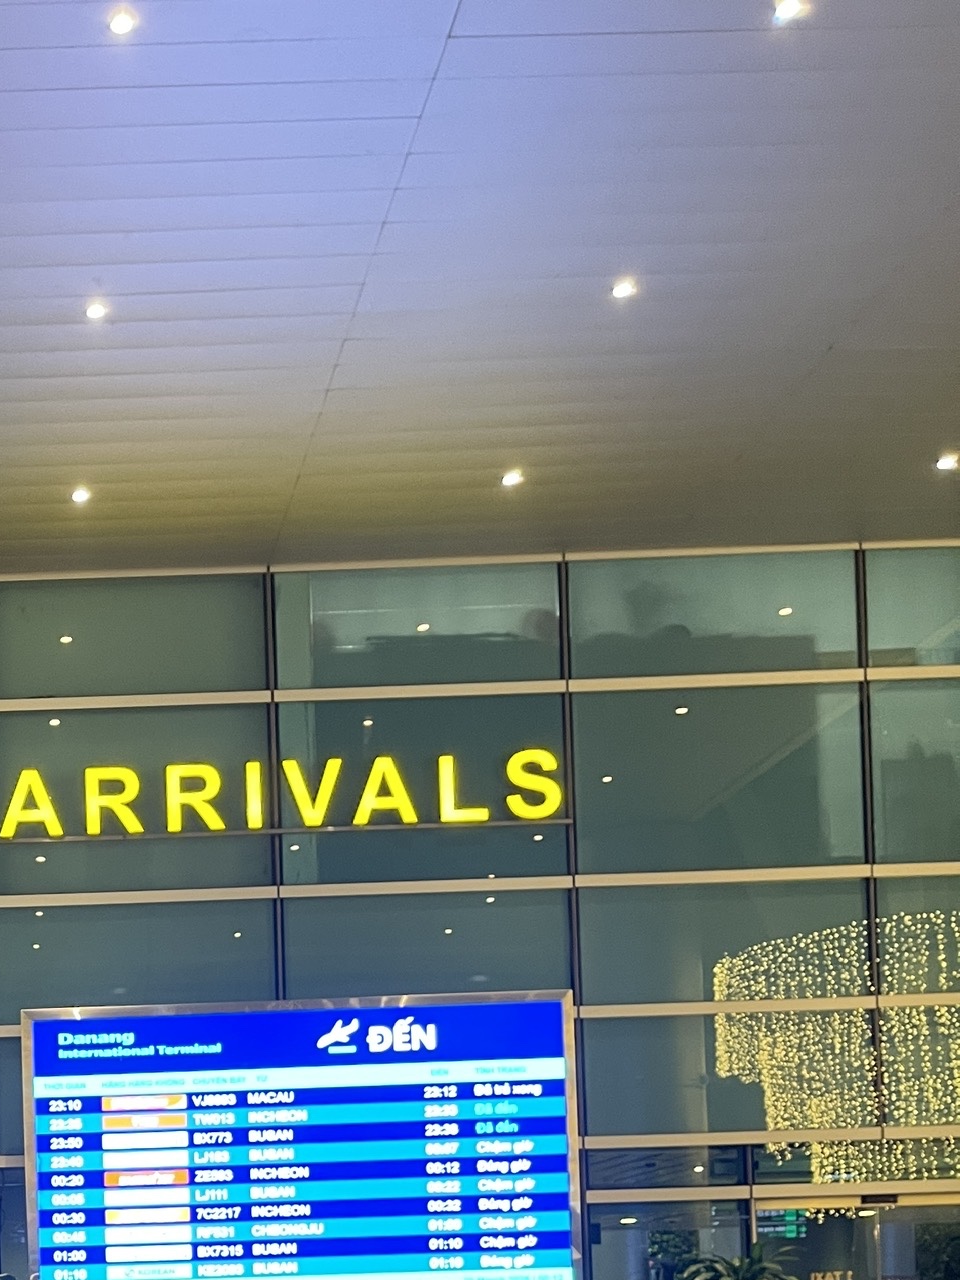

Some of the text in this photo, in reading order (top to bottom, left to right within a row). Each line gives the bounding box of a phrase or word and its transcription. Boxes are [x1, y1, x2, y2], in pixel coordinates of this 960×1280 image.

[0, 749, 562, 838] ARRIVALS
[58, 1032, 134, 1047] Danang
[366, 1017, 436, 1052] ĐẾN
[58, 1043, 221, 1059] International Terminal
[247, 1091, 294, 1104] MACAU
[250, 1167, 309, 1179] INCHEON
[196, 1207, 241, 1219] 7C2217
[251, 1204, 310, 1217] INCHEON
[54, 1250, 86, 1262] 01:00
